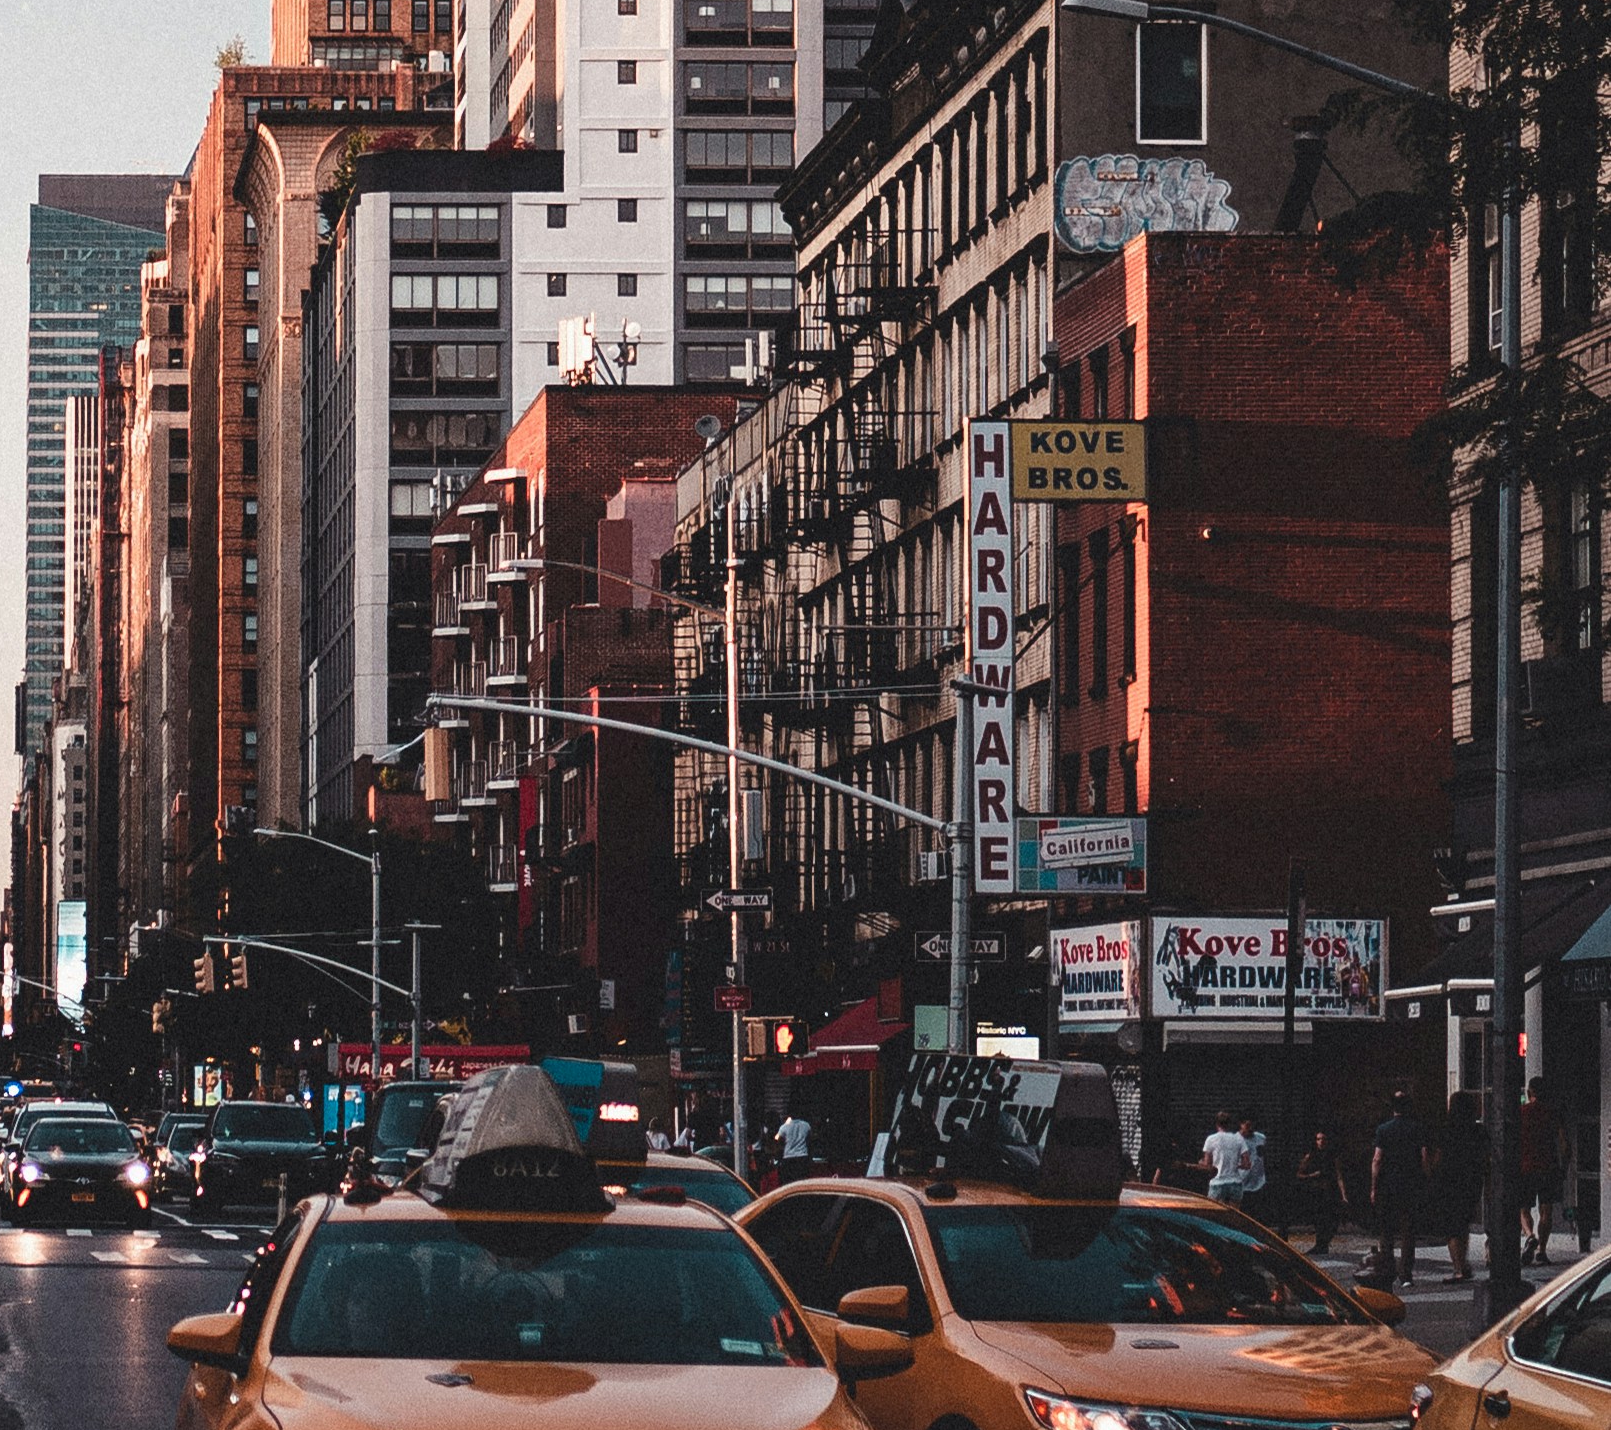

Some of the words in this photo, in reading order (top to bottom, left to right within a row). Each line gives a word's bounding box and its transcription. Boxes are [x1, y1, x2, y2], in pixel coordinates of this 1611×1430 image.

[1029, 430, 1125, 455] KOVE
[1028, 466, 1129, 491] BROS.
[973, 433, 1011, 881] HARDWARE
[1045, 833, 1130, 856] California
[714, 895, 733, 906] ONE
[743, 895, 765, 905] WAY
[929, 940, 951, 953] ON
[1059, 937, 1094, 965] Kove
[1096, 935, 1129, 962] Bros
[1177, 927, 1262, 957] Kove
[1063, 969, 1125, 995] HARDWARE
[976, 1026, 1007, 1035] Historic
[1007, 1026, 1027, 1036] NYC
